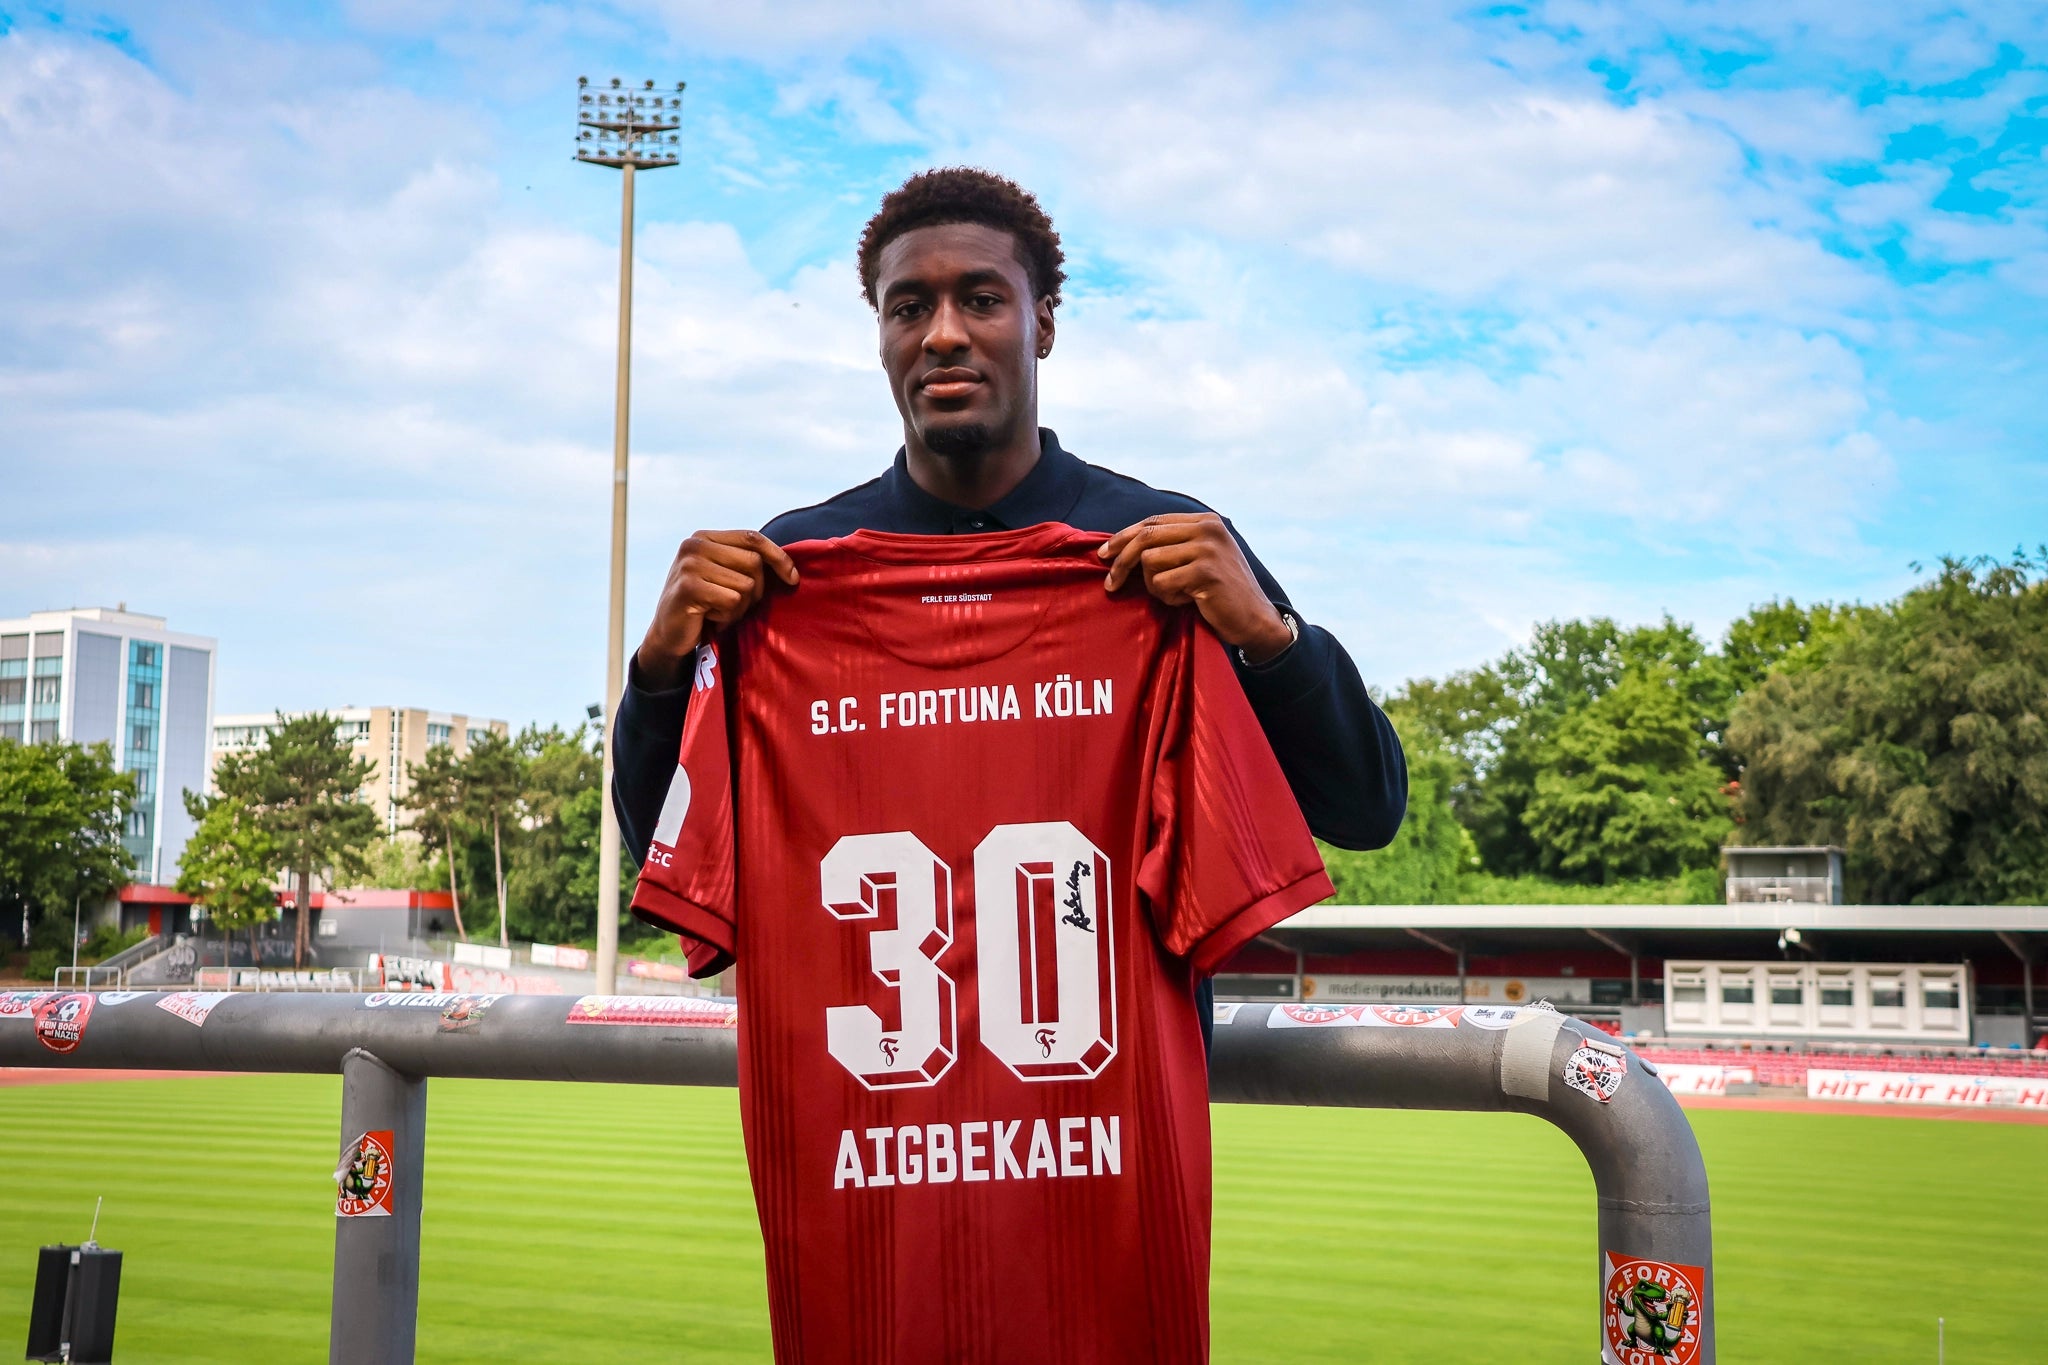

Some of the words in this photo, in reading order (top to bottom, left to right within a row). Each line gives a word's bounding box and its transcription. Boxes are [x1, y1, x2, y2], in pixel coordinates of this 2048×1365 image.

[921, 595, 943, 604] PERLE
[944, 595, 958, 603] DER
[958, 593, 993, 602] SÜDSTADT
[810, 696, 866, 735] S.C.
[880, 684, 1021, 729] FORTUNA
[1035, 674, 1113, 718] KÖLN
[820, 820, 1118, 1091] 30
[54, 1029, 79, 1041] NAZIS
[1817, 1080, 1870, 1097] HIT
[1879, 1082, 1935, 1099] HIT
[834, 1115, 1122, 1190] AIGBEKAEN
